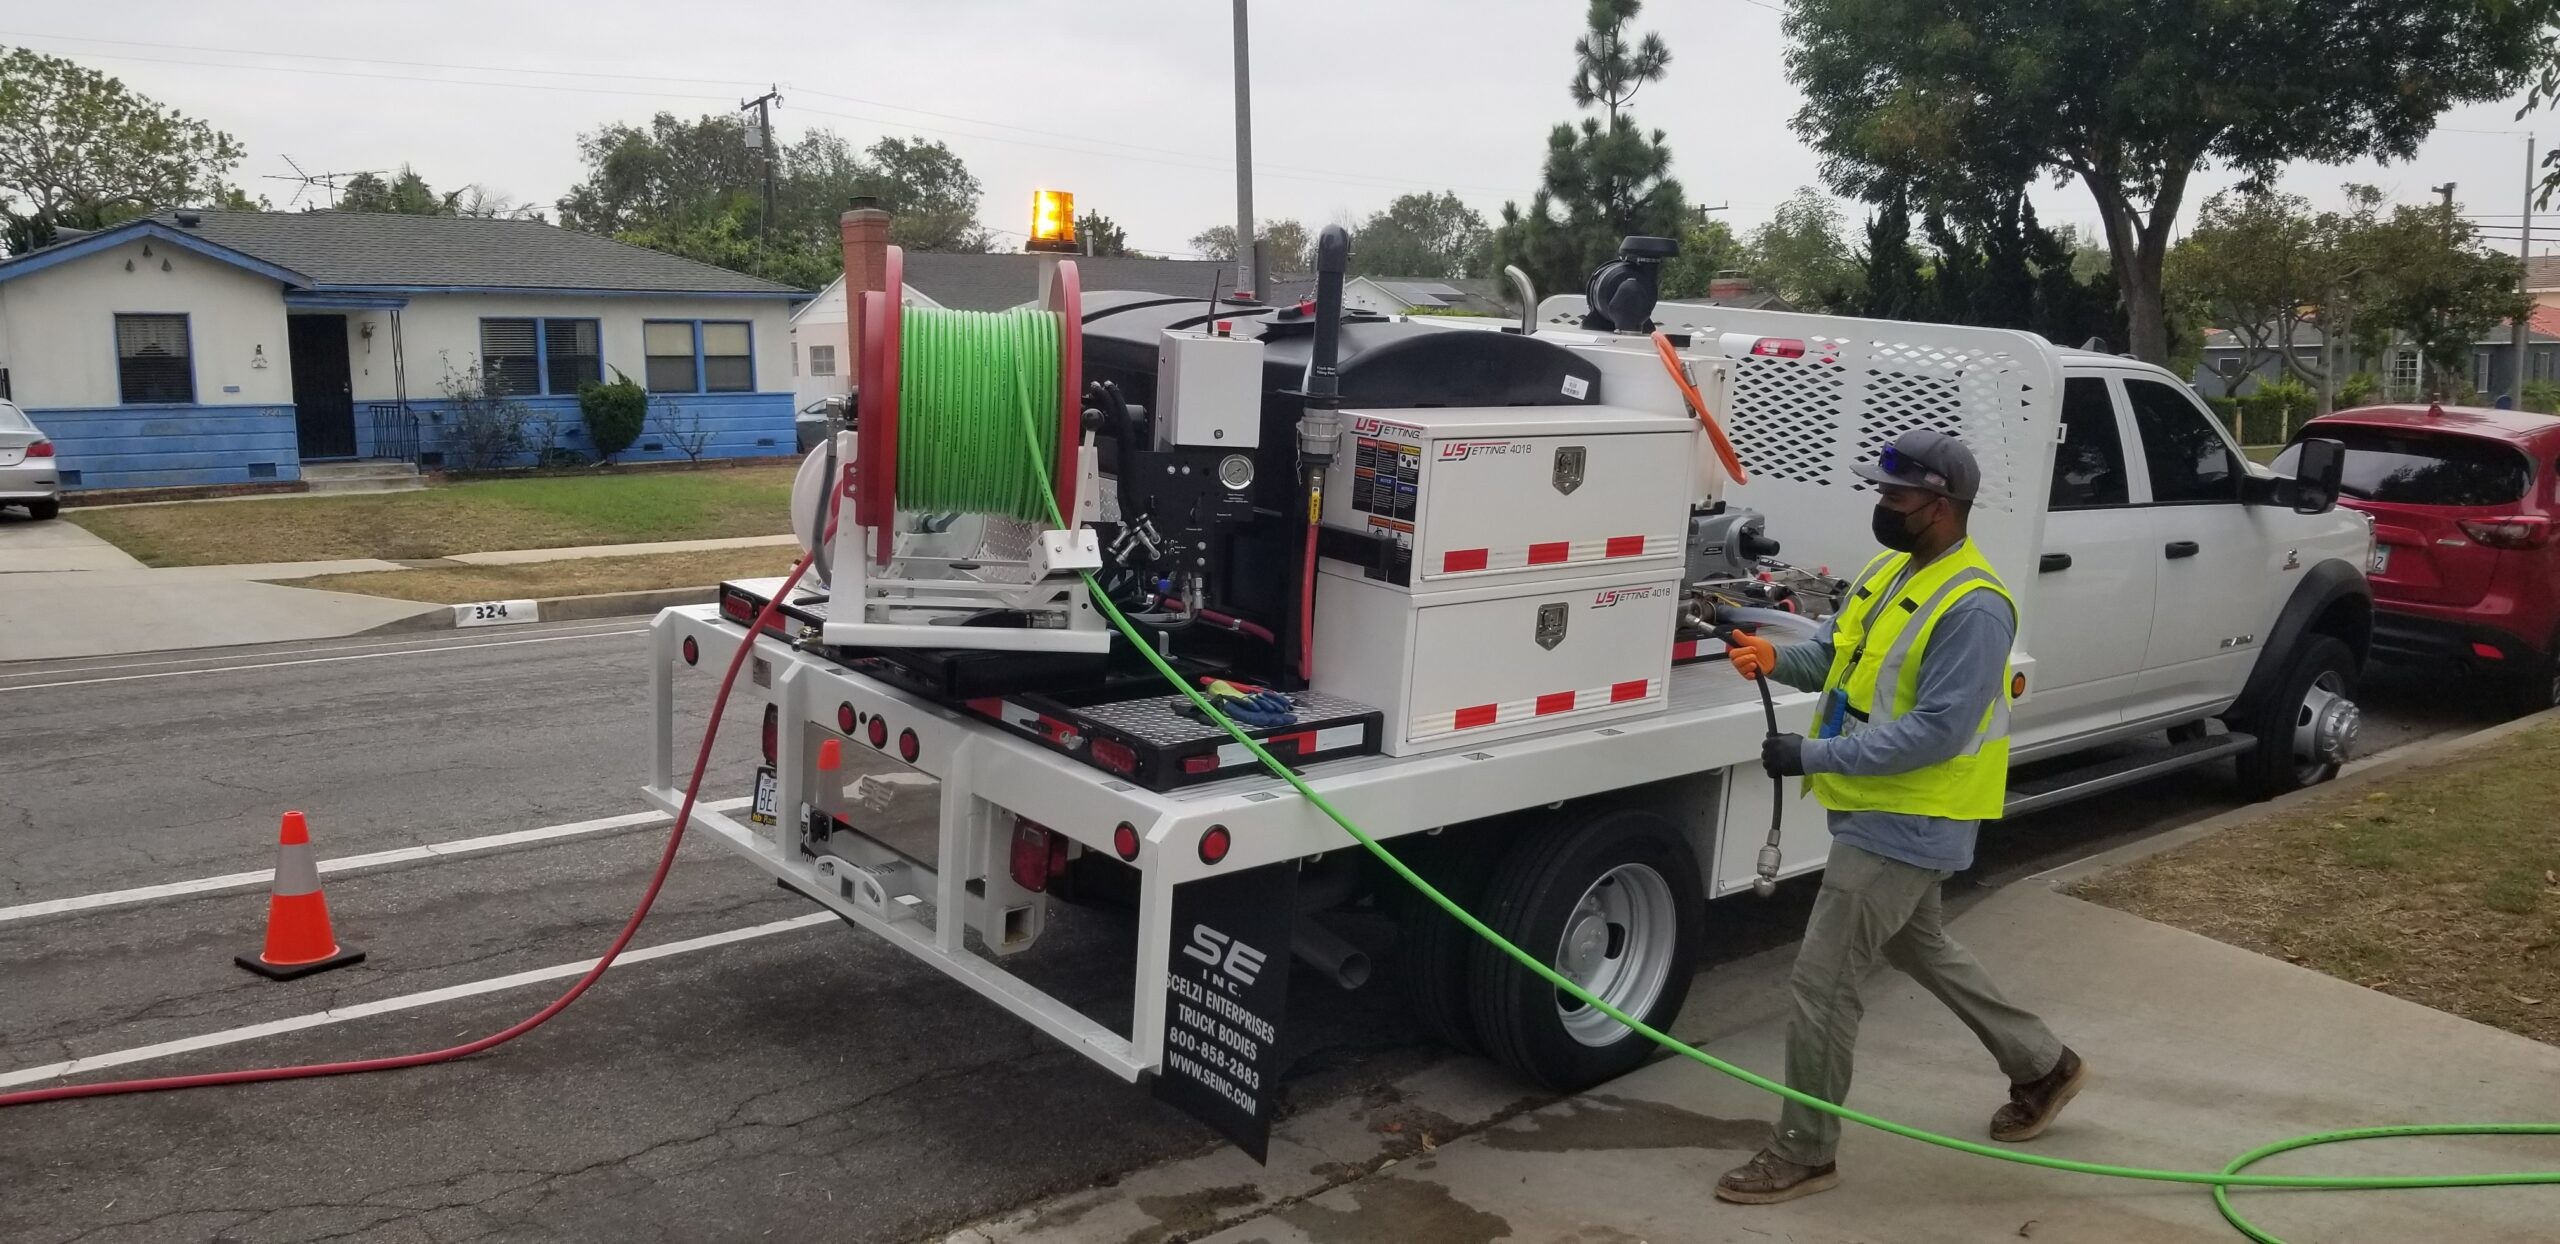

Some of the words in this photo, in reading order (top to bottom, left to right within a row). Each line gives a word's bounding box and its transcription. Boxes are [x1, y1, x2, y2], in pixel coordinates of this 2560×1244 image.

[1510, 444, 1532, 455] 4018
[475, 604, 508, 620] 324
[1652, 587, 1671, 598] 4018
[759, 788, 777, 812] BE
[1183, 923, 1267, 986] SE
[1202, 968, 1242, 998] INC.
[1166, 970, 1203, 1004] SCELZI
[1205, 989, 1275, 1045] ENTERPRISES
[1178, 1002, 1216, 1038] TRUCK
[1218, 1023, 1258, 1062] BODIES
[1169, 1026, 1260, 1091] 800-858-2883
[1169, 1050, 1257, 1117] WWW.SEINC.COM
